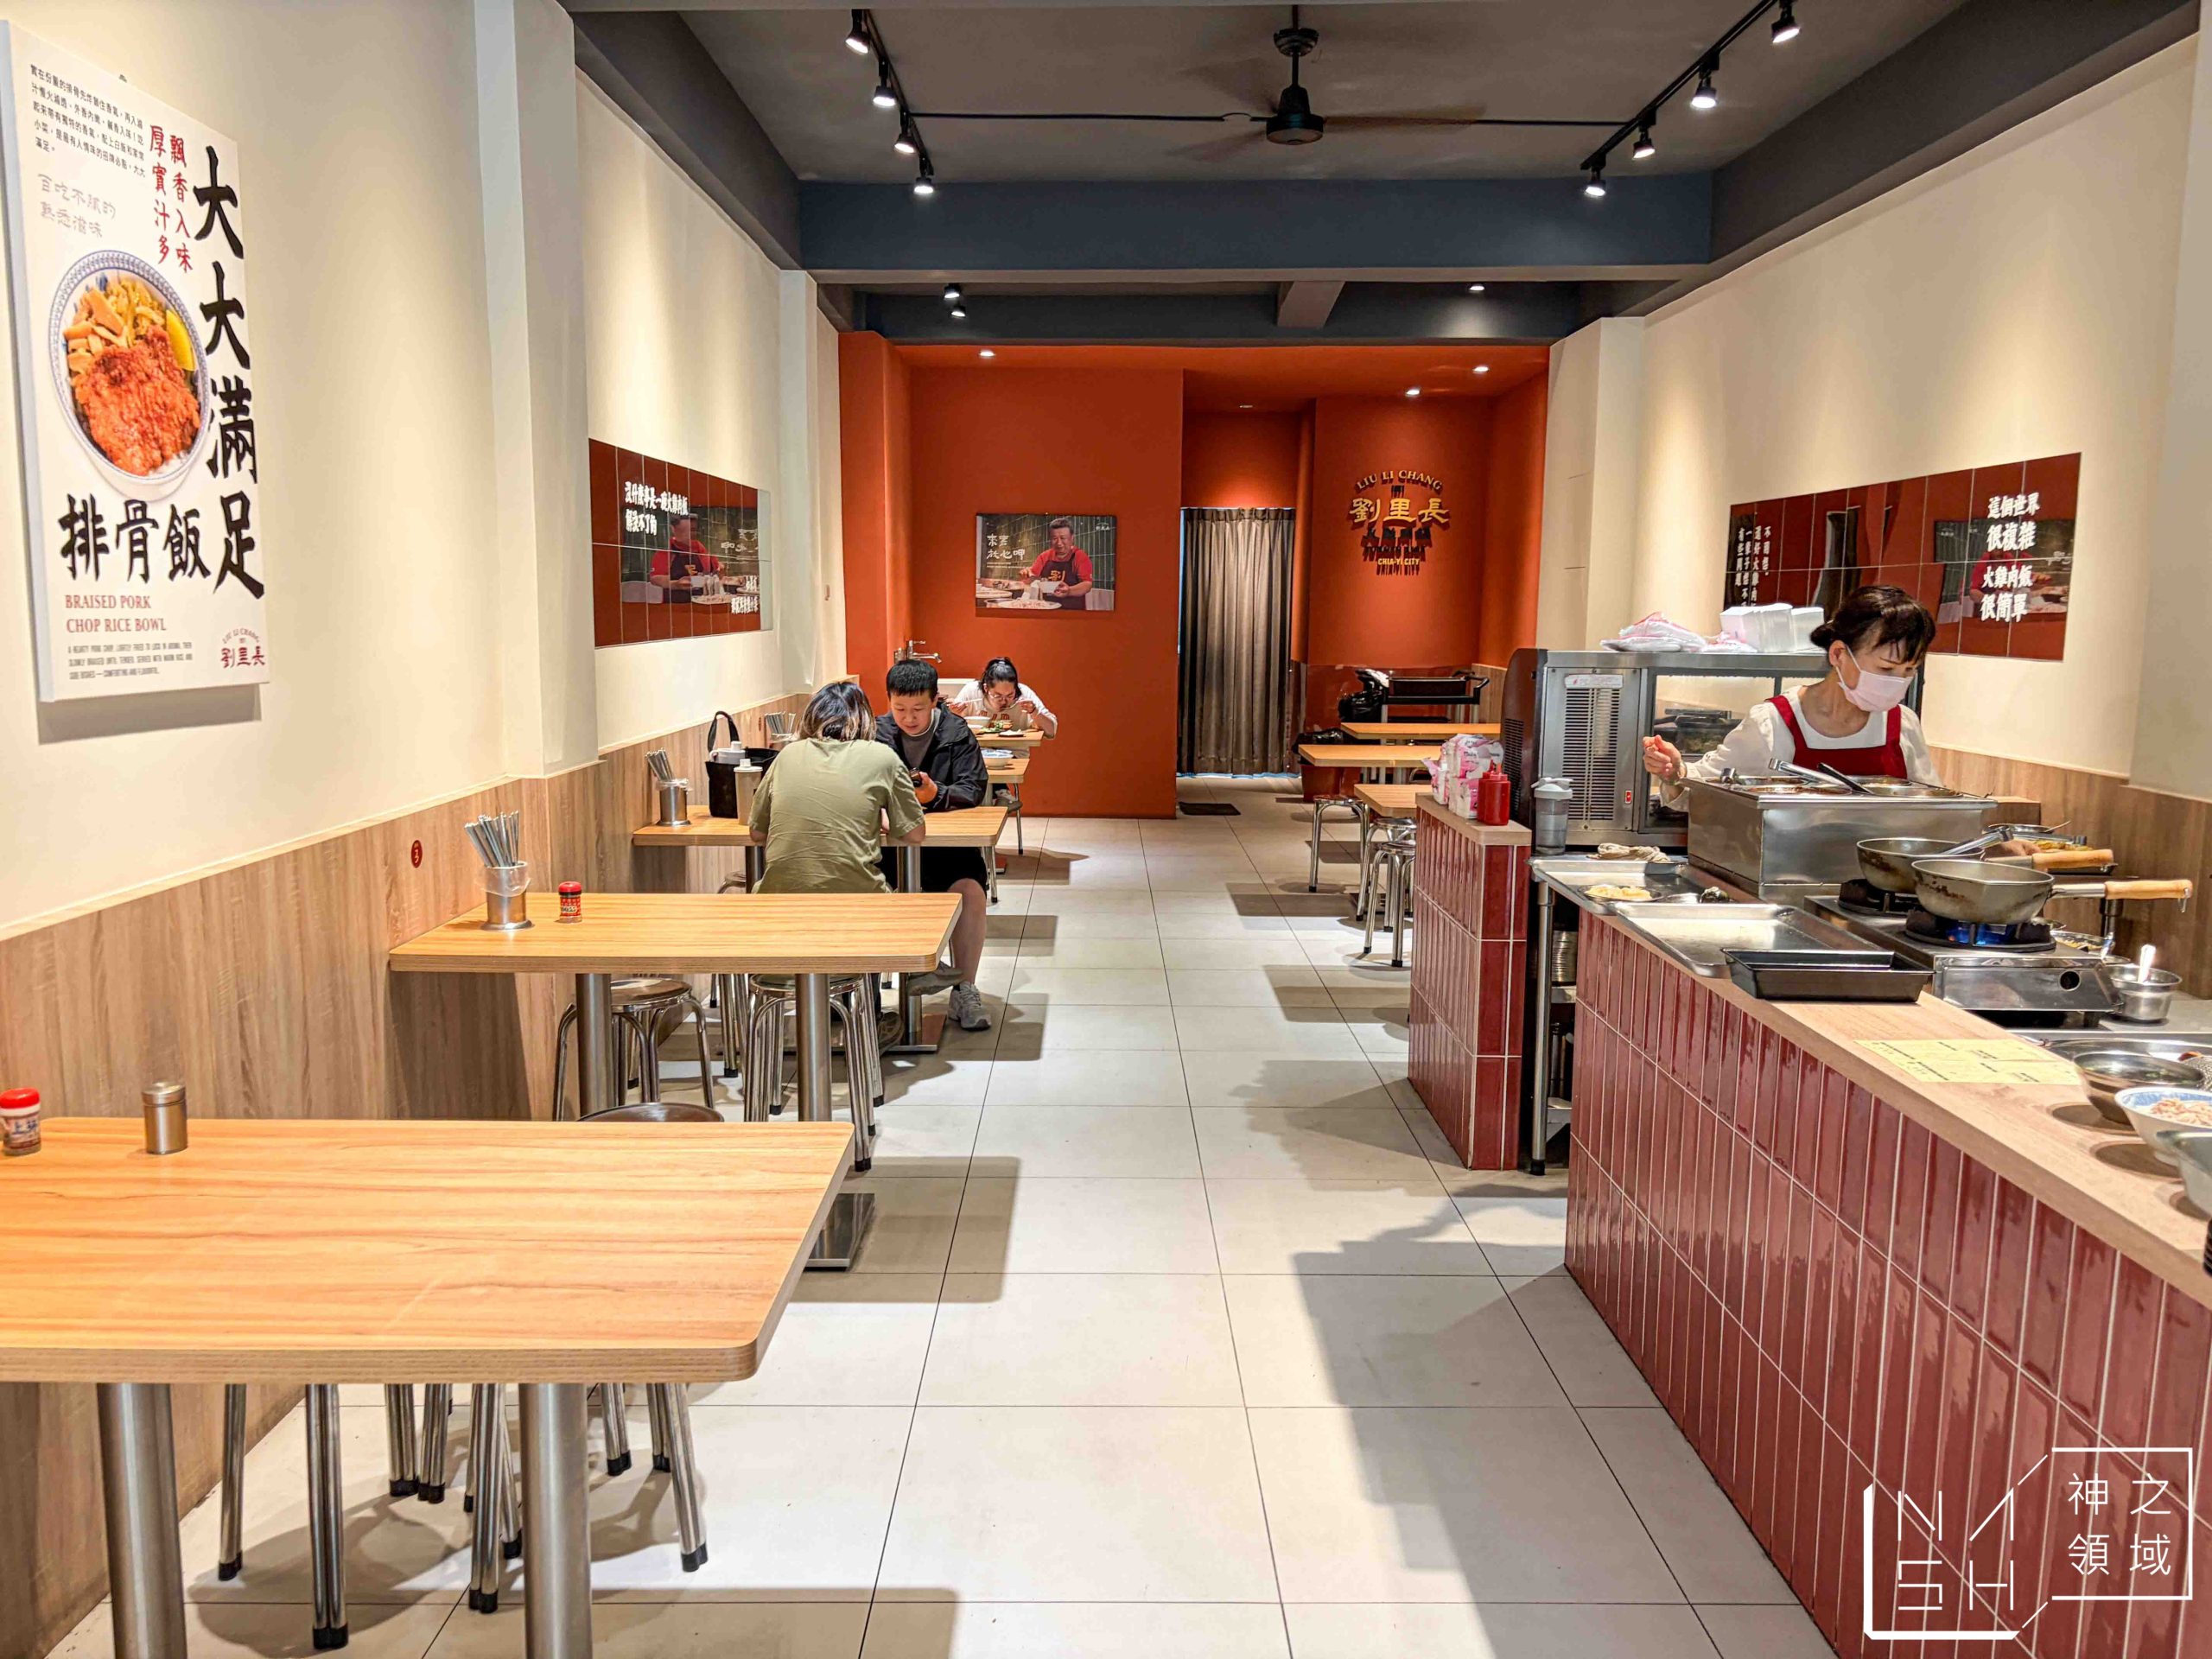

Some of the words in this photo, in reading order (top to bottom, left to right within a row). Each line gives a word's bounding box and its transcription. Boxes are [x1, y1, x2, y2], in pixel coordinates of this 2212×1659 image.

[149, 125, 171, 264] 厚實汁多
[169, 135, 194, 274] 飄香入味
[193, 145, 265, 600] 大大滿足
[1357, 474, 1378, 490] LIU
[1382, 471, 1394, 480] LI
[1398, 469, 1443, 491] CHANG
[1349, 497, 1449, 524] 劉里長
[1986, 492, 2041, 519] 這個世界
[625, 508, 658, 536] 解決不了的
[1986, 520, 2037, 552] 很複雜
[57, 493, 211, 584] 排骨飯
[1741, 530, 1752, 607] 一輩子想不
[1751, 524, 1762, 607] 還好火雞肉
[1981, 564, 2033, 589] 火雞肉飯
[65, 594, 117, 609] BRAISED
[120, 594, 152, 609] PORK
[1980, 592, 2029, 623] 很簡單
[67, 619, 101, 632] CHOP
[105, 619, 131, 632] RICE
[135, 618, 167, 632] BOWL
[220, 645, 265, 669] 劉里長
